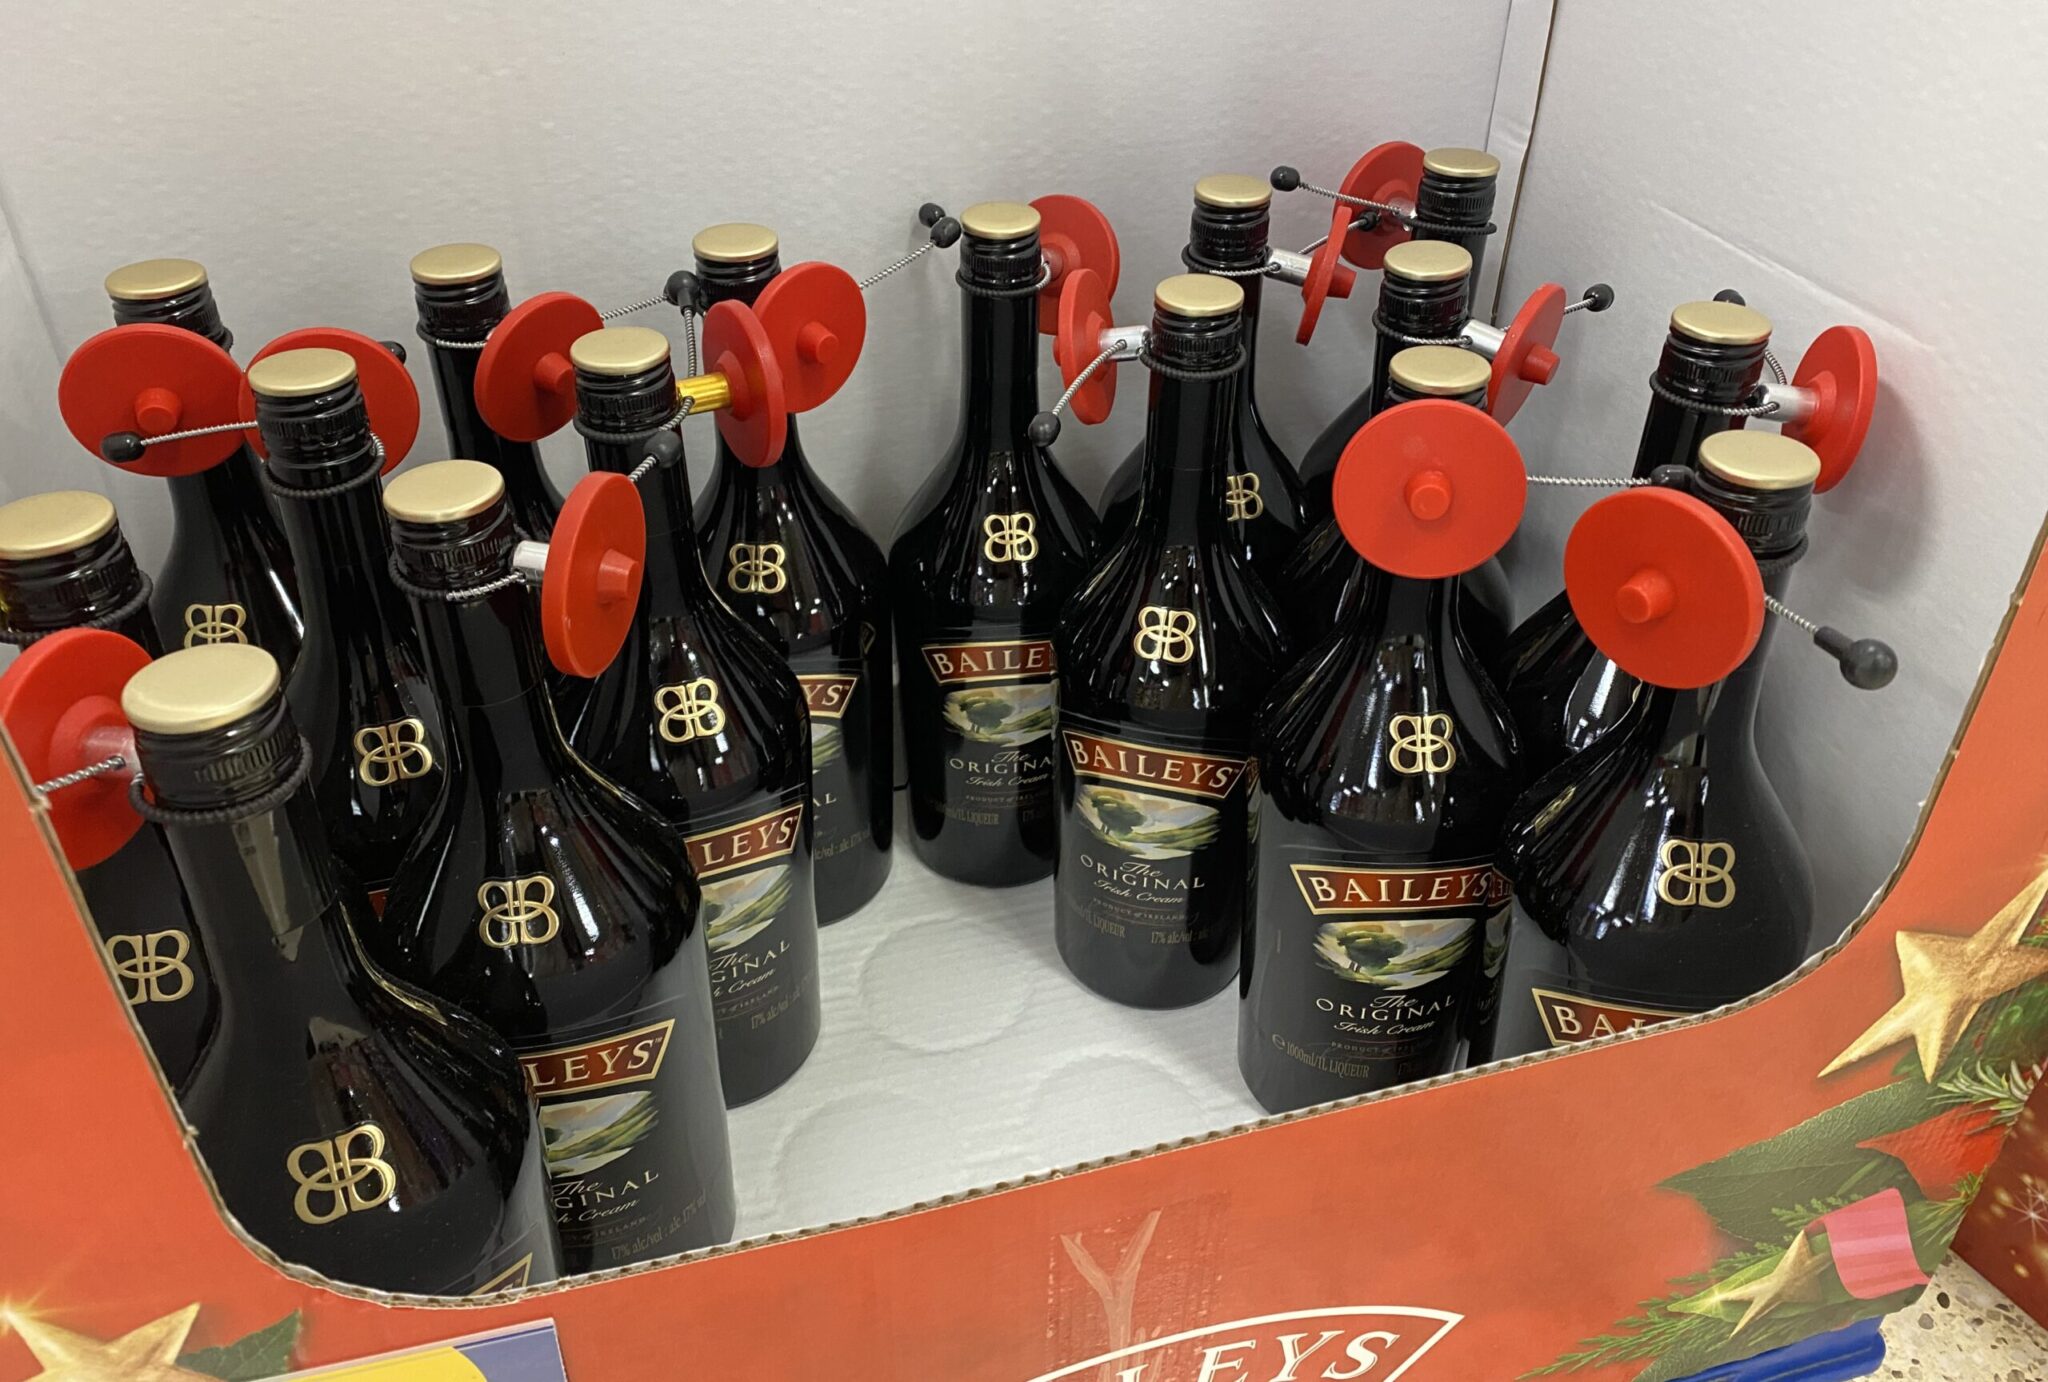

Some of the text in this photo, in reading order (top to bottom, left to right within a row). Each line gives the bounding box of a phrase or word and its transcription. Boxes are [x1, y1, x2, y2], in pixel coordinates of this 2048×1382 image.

[933, 648, 1047, 675] BAILE
[950, 756, 1051, 774] ORIGINA
[1071, 739, 1234, 789] BAILEYS
[702, 817, 796, 866] LEYS
[1080, 854, 1205, 890] ORIGINAL
[1120, 862, 1163, 877] The
[1093, 879, 1184, 904] Irish Cream
[1309, 872, 1492, 902] BAILEYS
[711, 940, 790, 983] GINAL
[1316, 995, 1455, 1021] ORIGINAL
[1370, 995, 1418, 1008] The
[1334, 1021, 1435, 1035] Irish Cream
[525, 1038, 653, 1087] LEYS
[1330, 1060, 1369, 1079] LIQUEUR
[554, 1170, 659, 1209] GINAL
[578, 1199, 640, 1222] Cream
